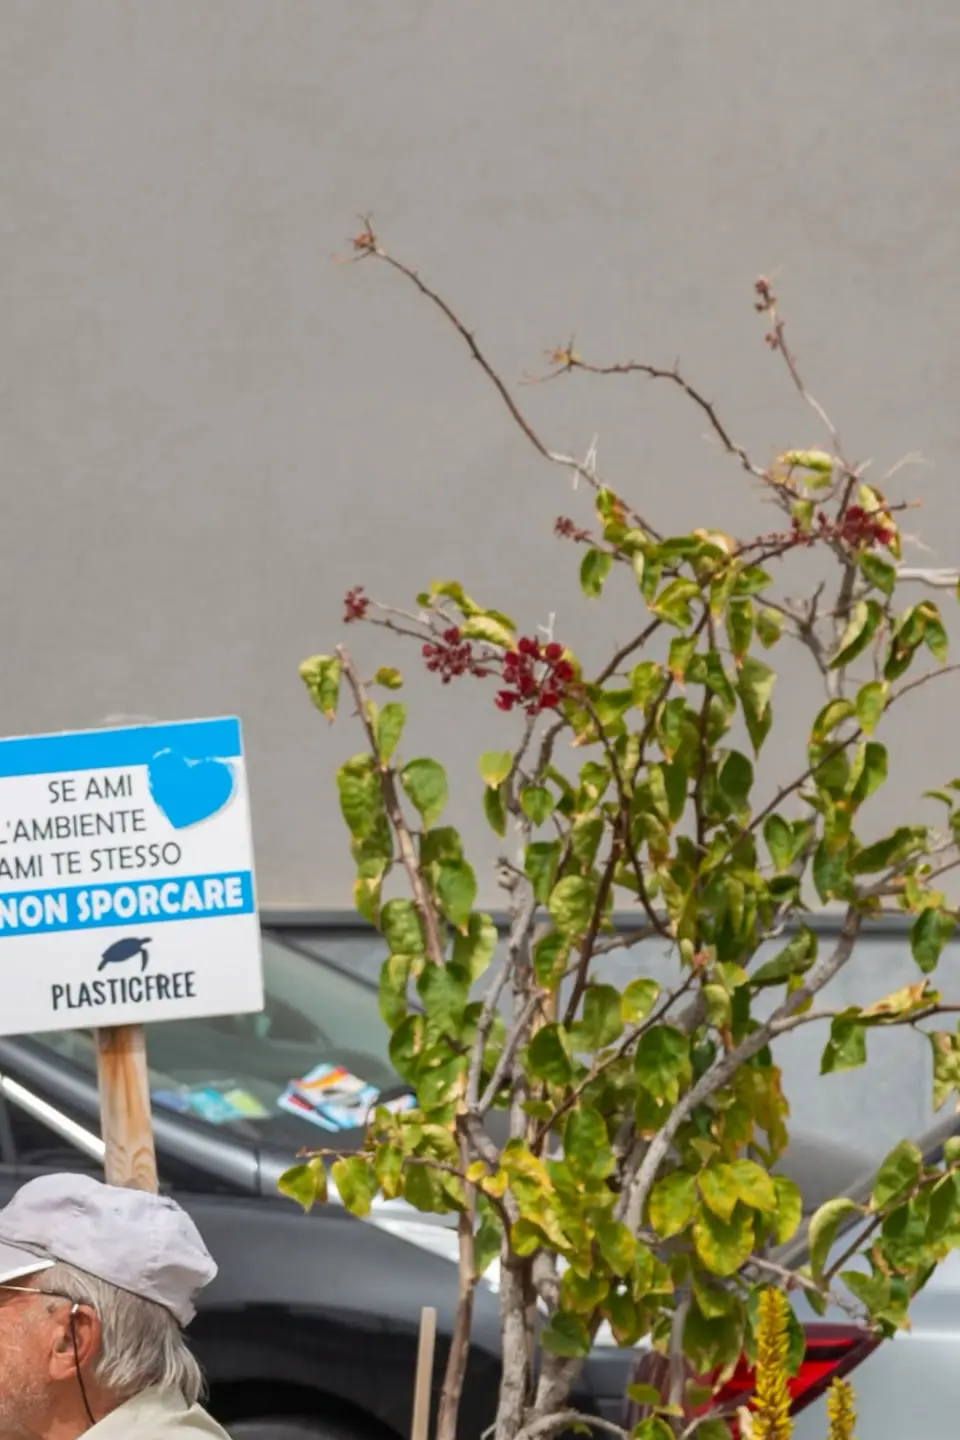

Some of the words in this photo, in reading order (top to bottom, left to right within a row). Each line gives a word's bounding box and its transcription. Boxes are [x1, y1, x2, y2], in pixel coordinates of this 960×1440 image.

[48, 779, 77, 804] SE
[85, 774, 133, 800] AMI
[51, 851, 82, 875] TE
[90, 842, 182, 872] STESSO
[77, 876, 244, 922] SPORCARE
[51, 970, 197, 1011] PLASTICFREE
